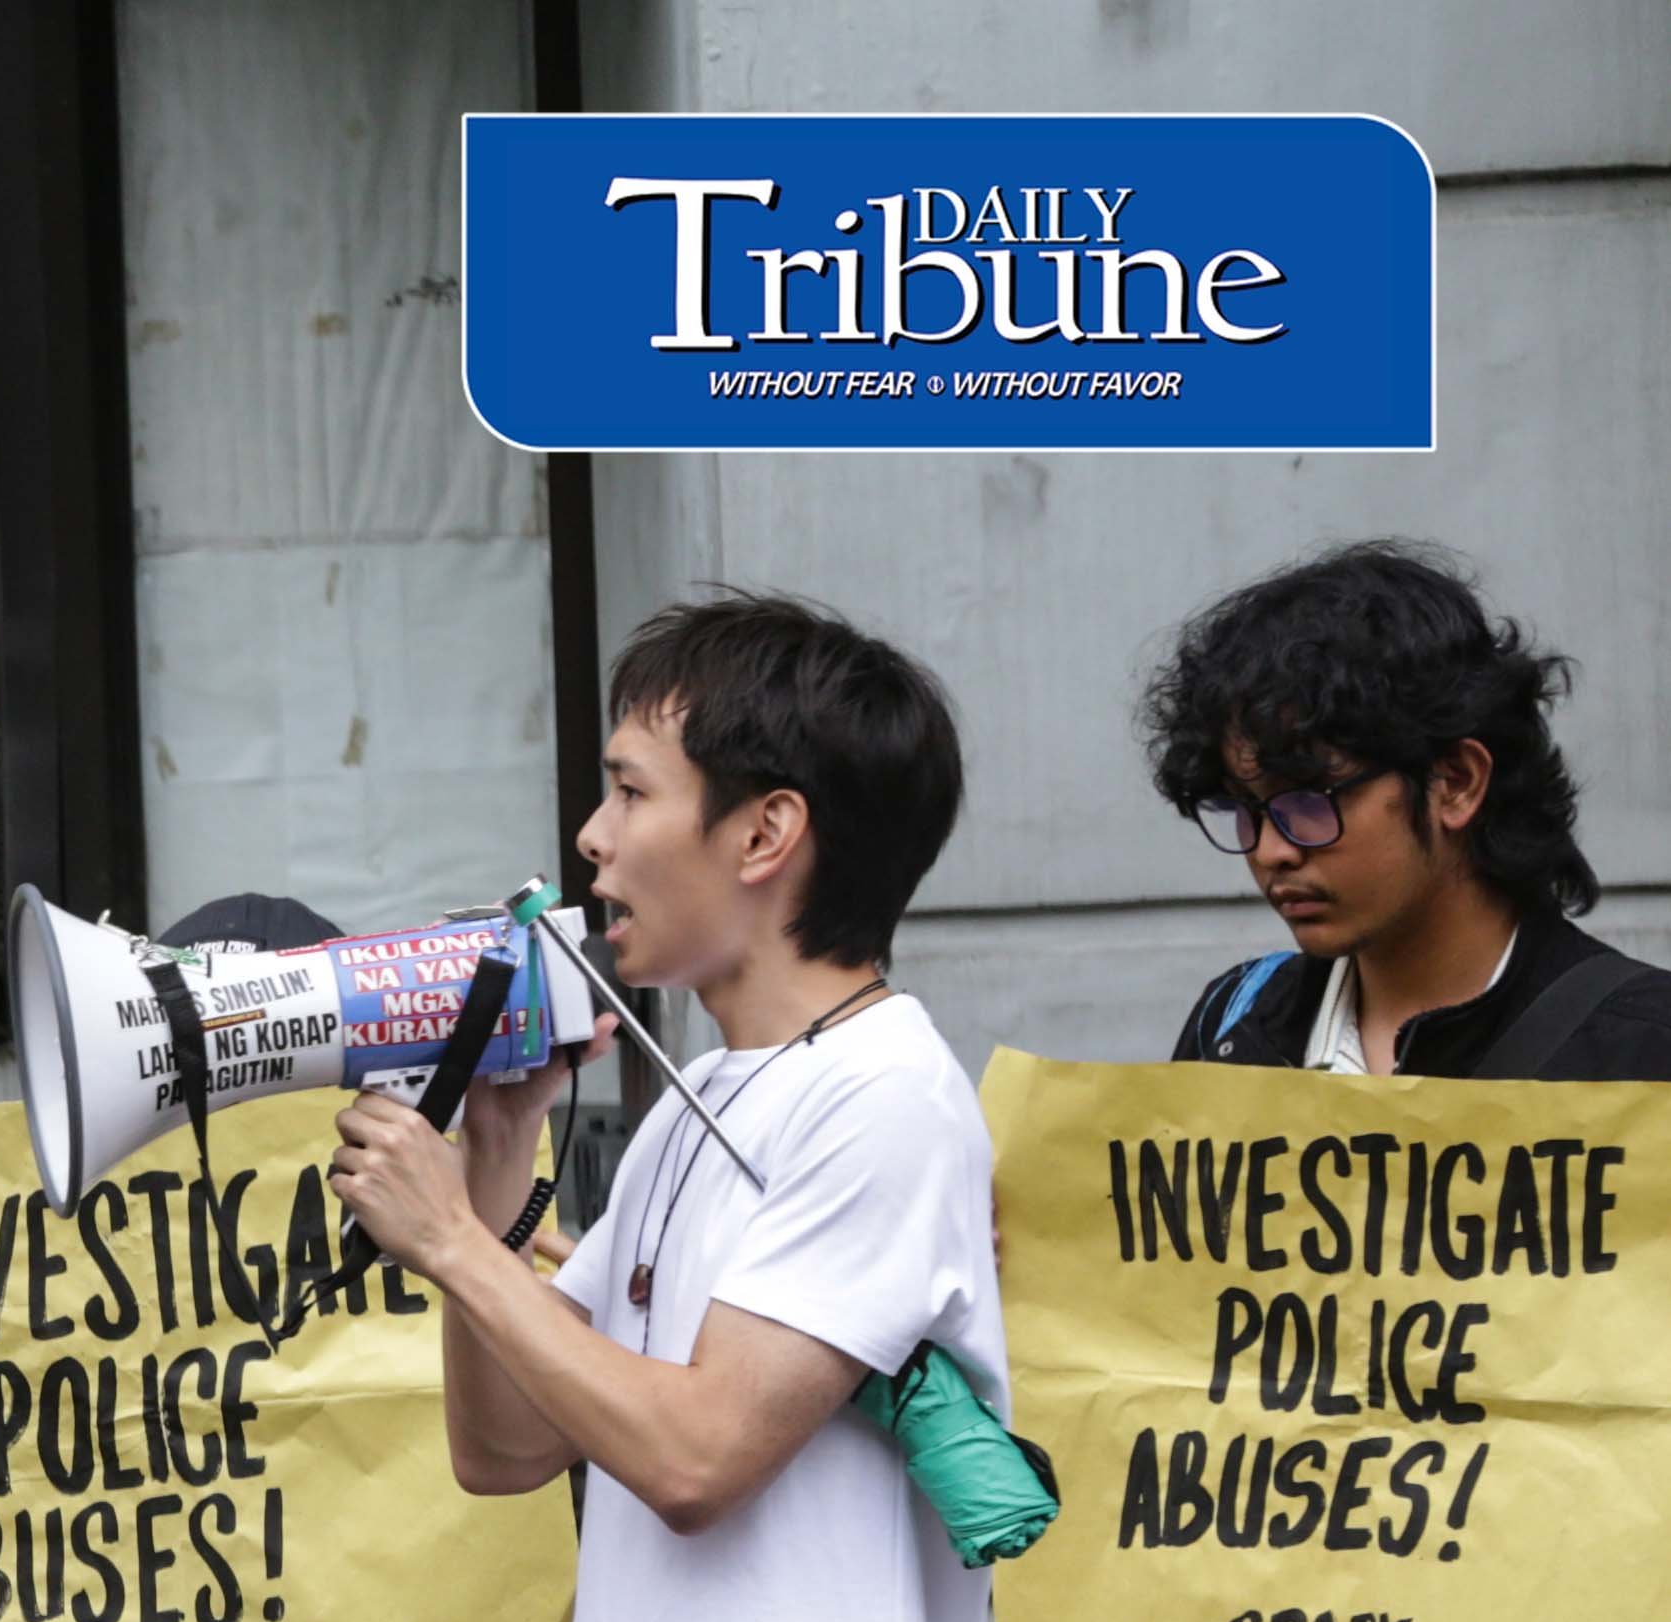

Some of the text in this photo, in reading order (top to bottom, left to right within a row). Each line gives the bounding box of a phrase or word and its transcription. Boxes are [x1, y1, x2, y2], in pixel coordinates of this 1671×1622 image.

[339, 931, 495, 965] IKULONG
[116, 991, 206, 1029] MARS
[209, 968, 315, 1013] SINGILIN!
[354, 966, 401, 992] NA
[383, 988, 463, 1016] MGA
[215, 1027, 248, 1061] NG
[256, 1013, 337, 1053] KORAP
[343, 1012, 508, 1048] KURAKT
[156, 1056, 294, 1111] PAAGUTIN!
[1107, 1133, 1625, 1281] INVESTIGATE
[1208, 1287, 1489, 1425] POLICE
[1118, 1428, 1489, 1563] ABUSES!
